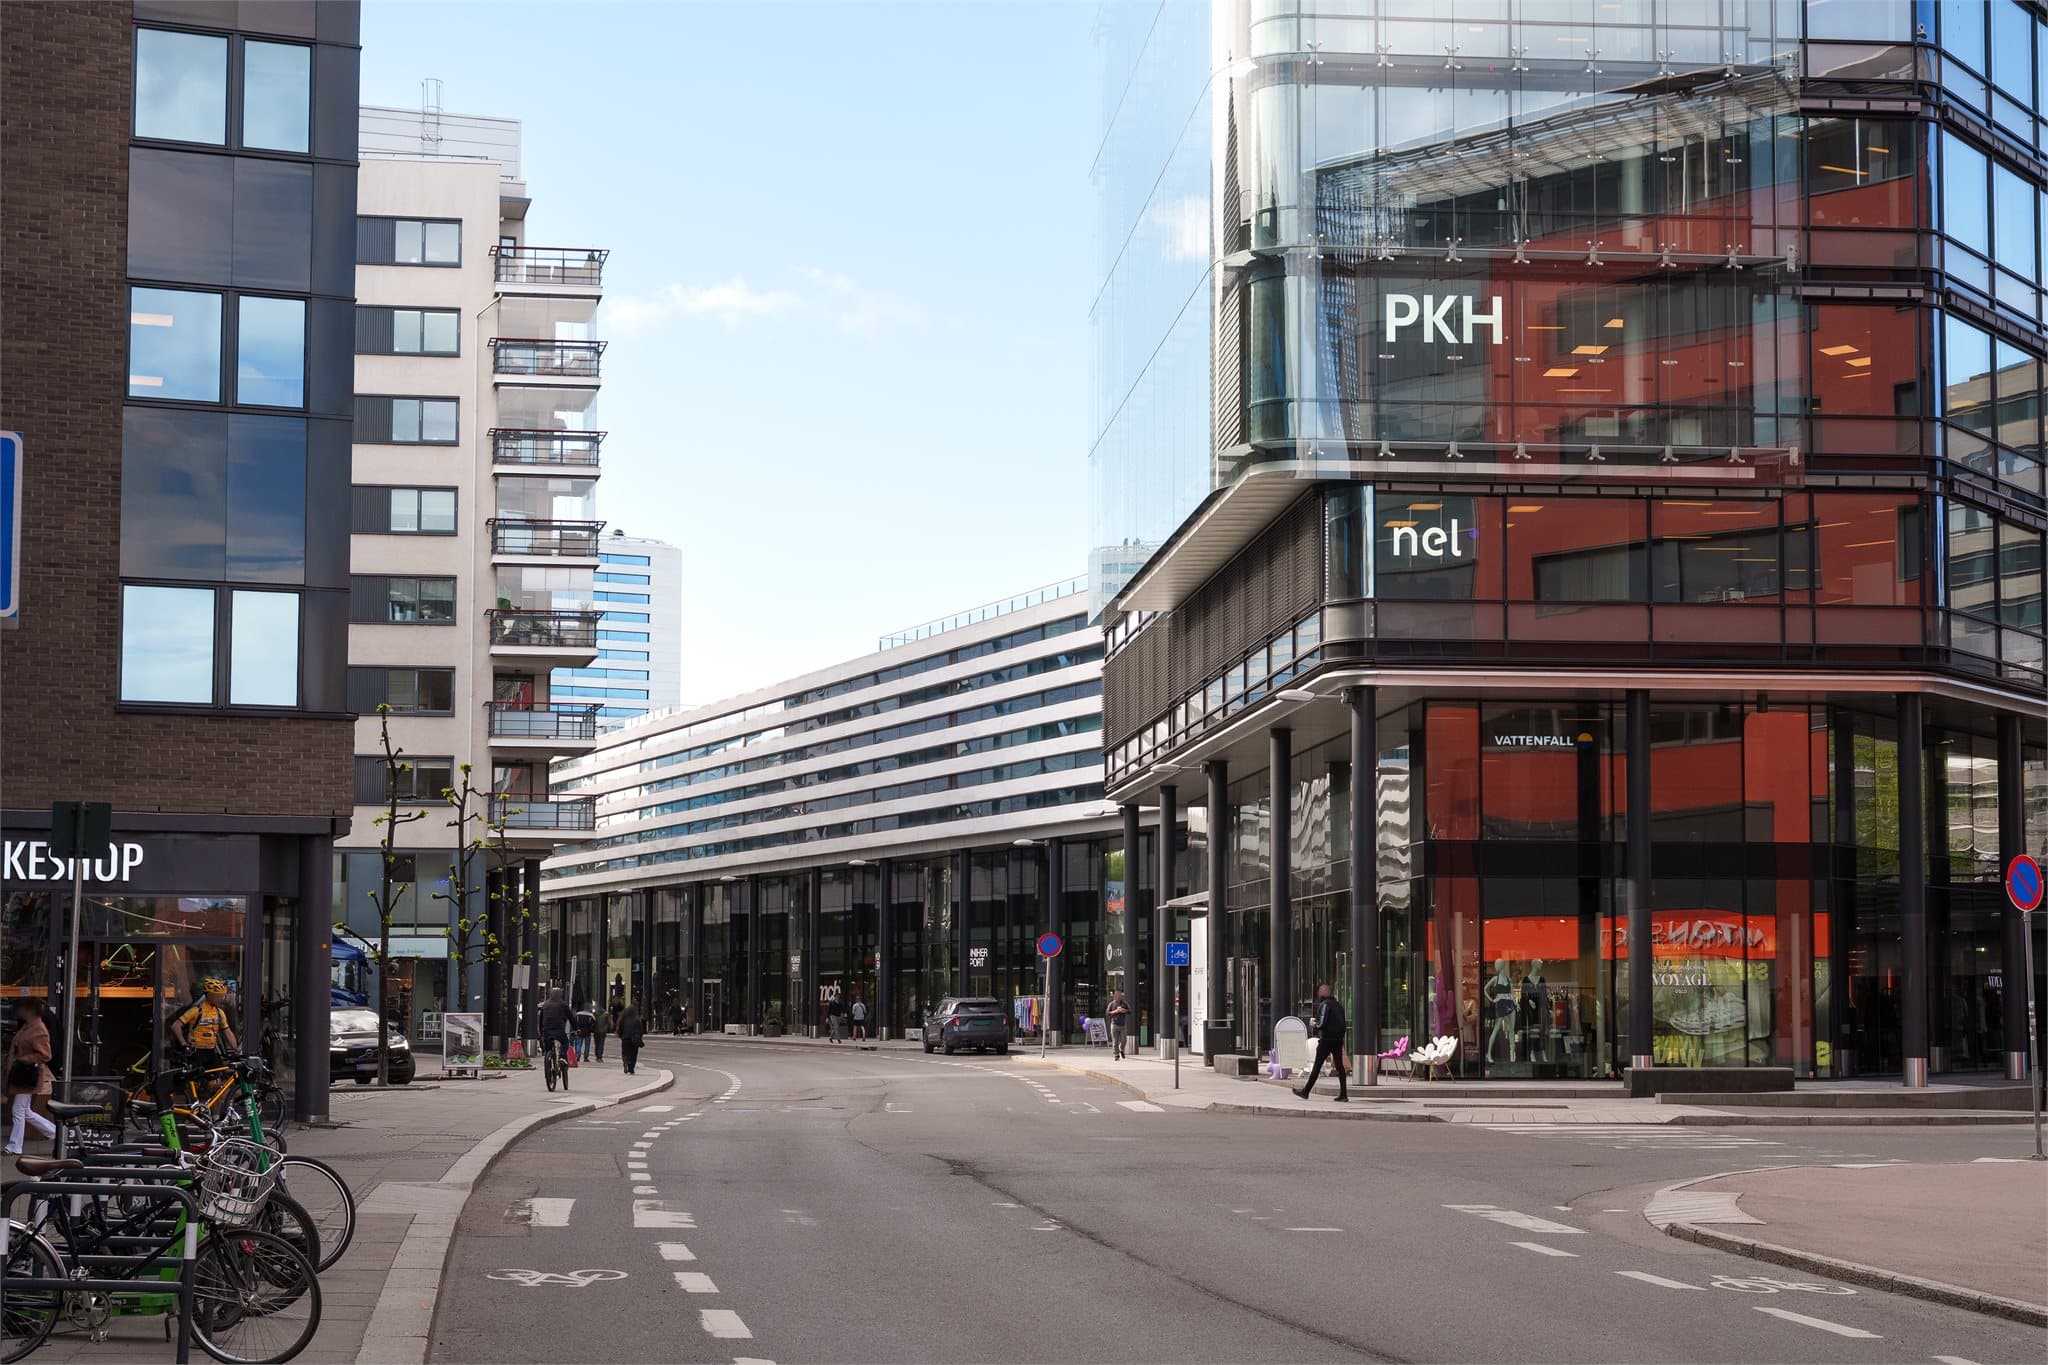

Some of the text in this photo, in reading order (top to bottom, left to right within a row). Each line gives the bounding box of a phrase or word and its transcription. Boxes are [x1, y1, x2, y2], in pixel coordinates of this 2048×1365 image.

[1386, 294, 1502, 344] PKH
[1393, 519, 1462, 556] nel
[1495, 735, 1574, 746] VATTENFALL
[244, 1097, 255, 1118] Bolt
